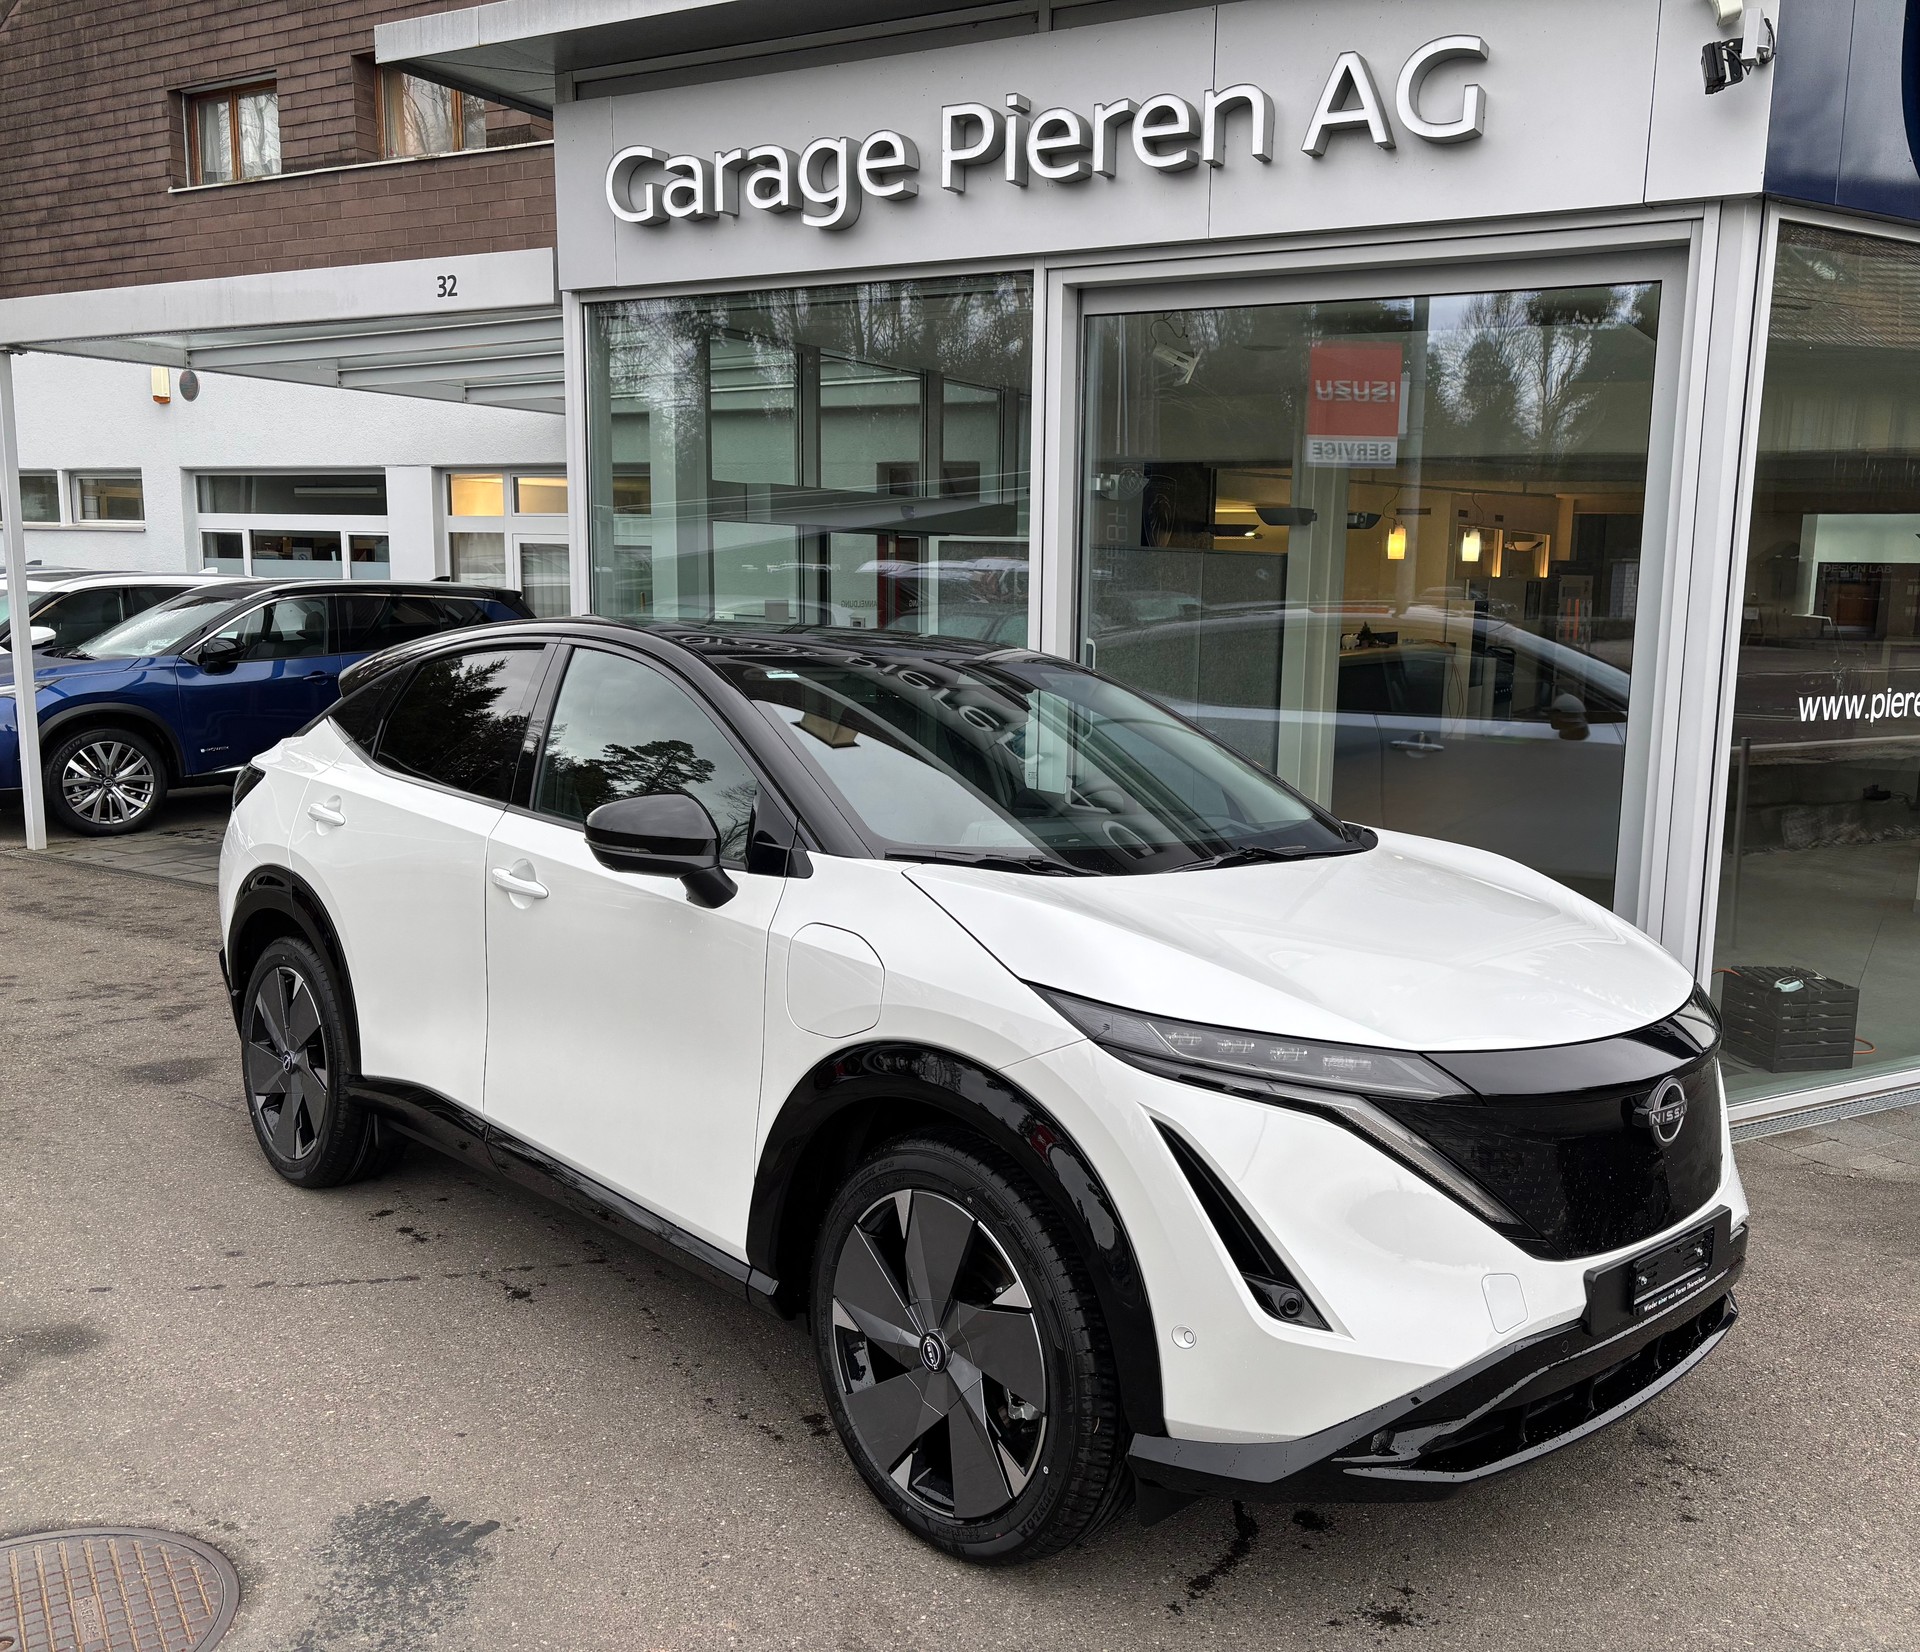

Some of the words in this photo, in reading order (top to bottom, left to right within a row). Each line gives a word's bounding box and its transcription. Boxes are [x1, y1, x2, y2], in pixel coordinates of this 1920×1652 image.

[604, 129, 919, 230] Garage
[940, 83, 1274, 193] Pieren
[1300, 34, 1490, 158] AG
[436, 274, 458, 299] 32
[1822, 563, 1867, 574] DESIGN
[1869, 564, 1893, 575] LAB
